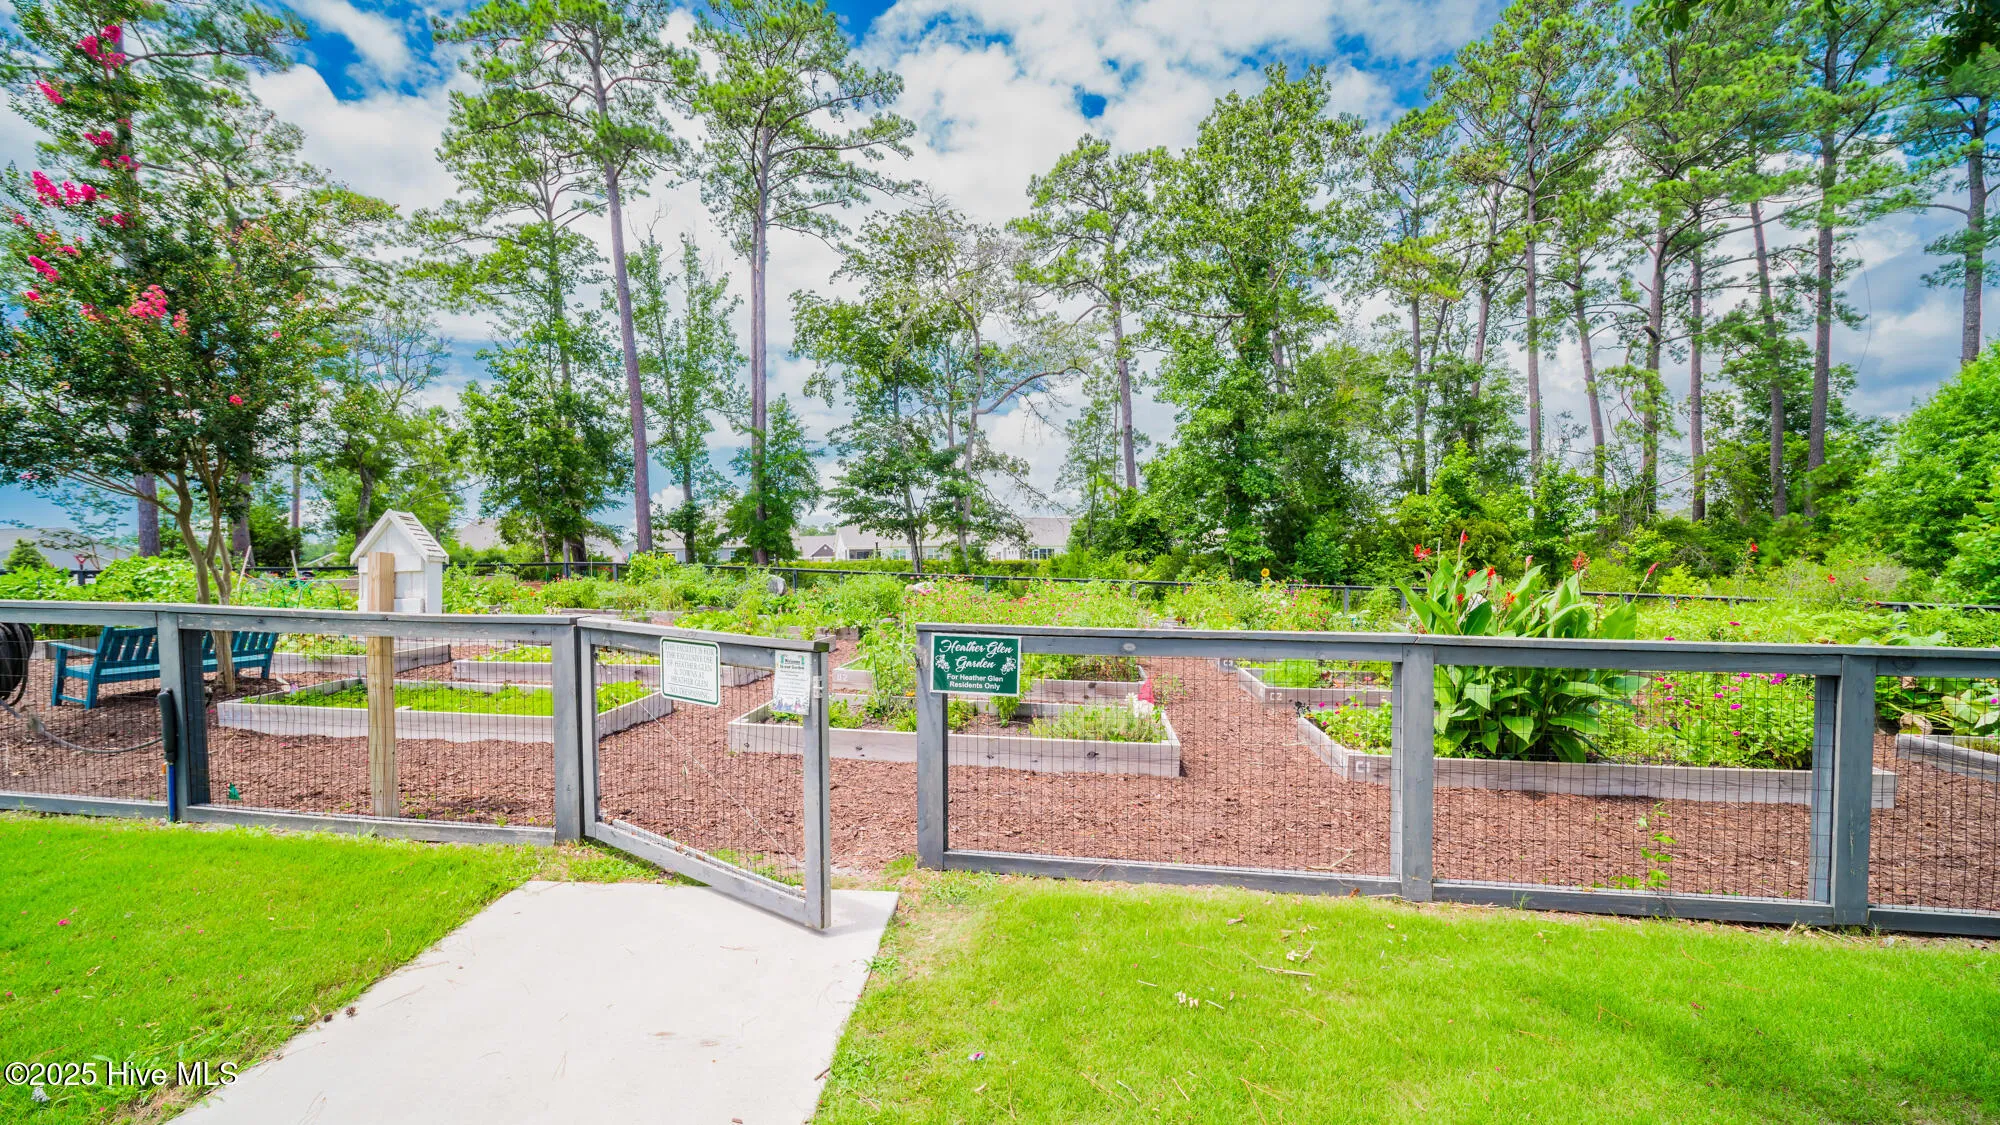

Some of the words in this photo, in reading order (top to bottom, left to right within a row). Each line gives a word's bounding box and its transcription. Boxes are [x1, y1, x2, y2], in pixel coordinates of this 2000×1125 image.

[677, 644, 697, 653] FACILITY
[704, 648, 714, 656] FOR
[939, 639, 985, 654] Heather
[986, 641, 1013, 658] Glen
[677, 652, 702, 662] EXCLUSIVE
[675, 661, 697, 670] HEATHER
[698, 664, 712, 672] GLEN
[955, 656, 996, 672] Garden
[671, 675, 694, 685] HEATHER
[695, 679, 709, 688] GLEN
[959, 674, 986, 682] Heather
[949, 681, 983, 689] Residents
[984, 682, 1000, 691] Only
[1269, 692, 1282, 701] C2
[1355, 760, 1370, 773] C1
